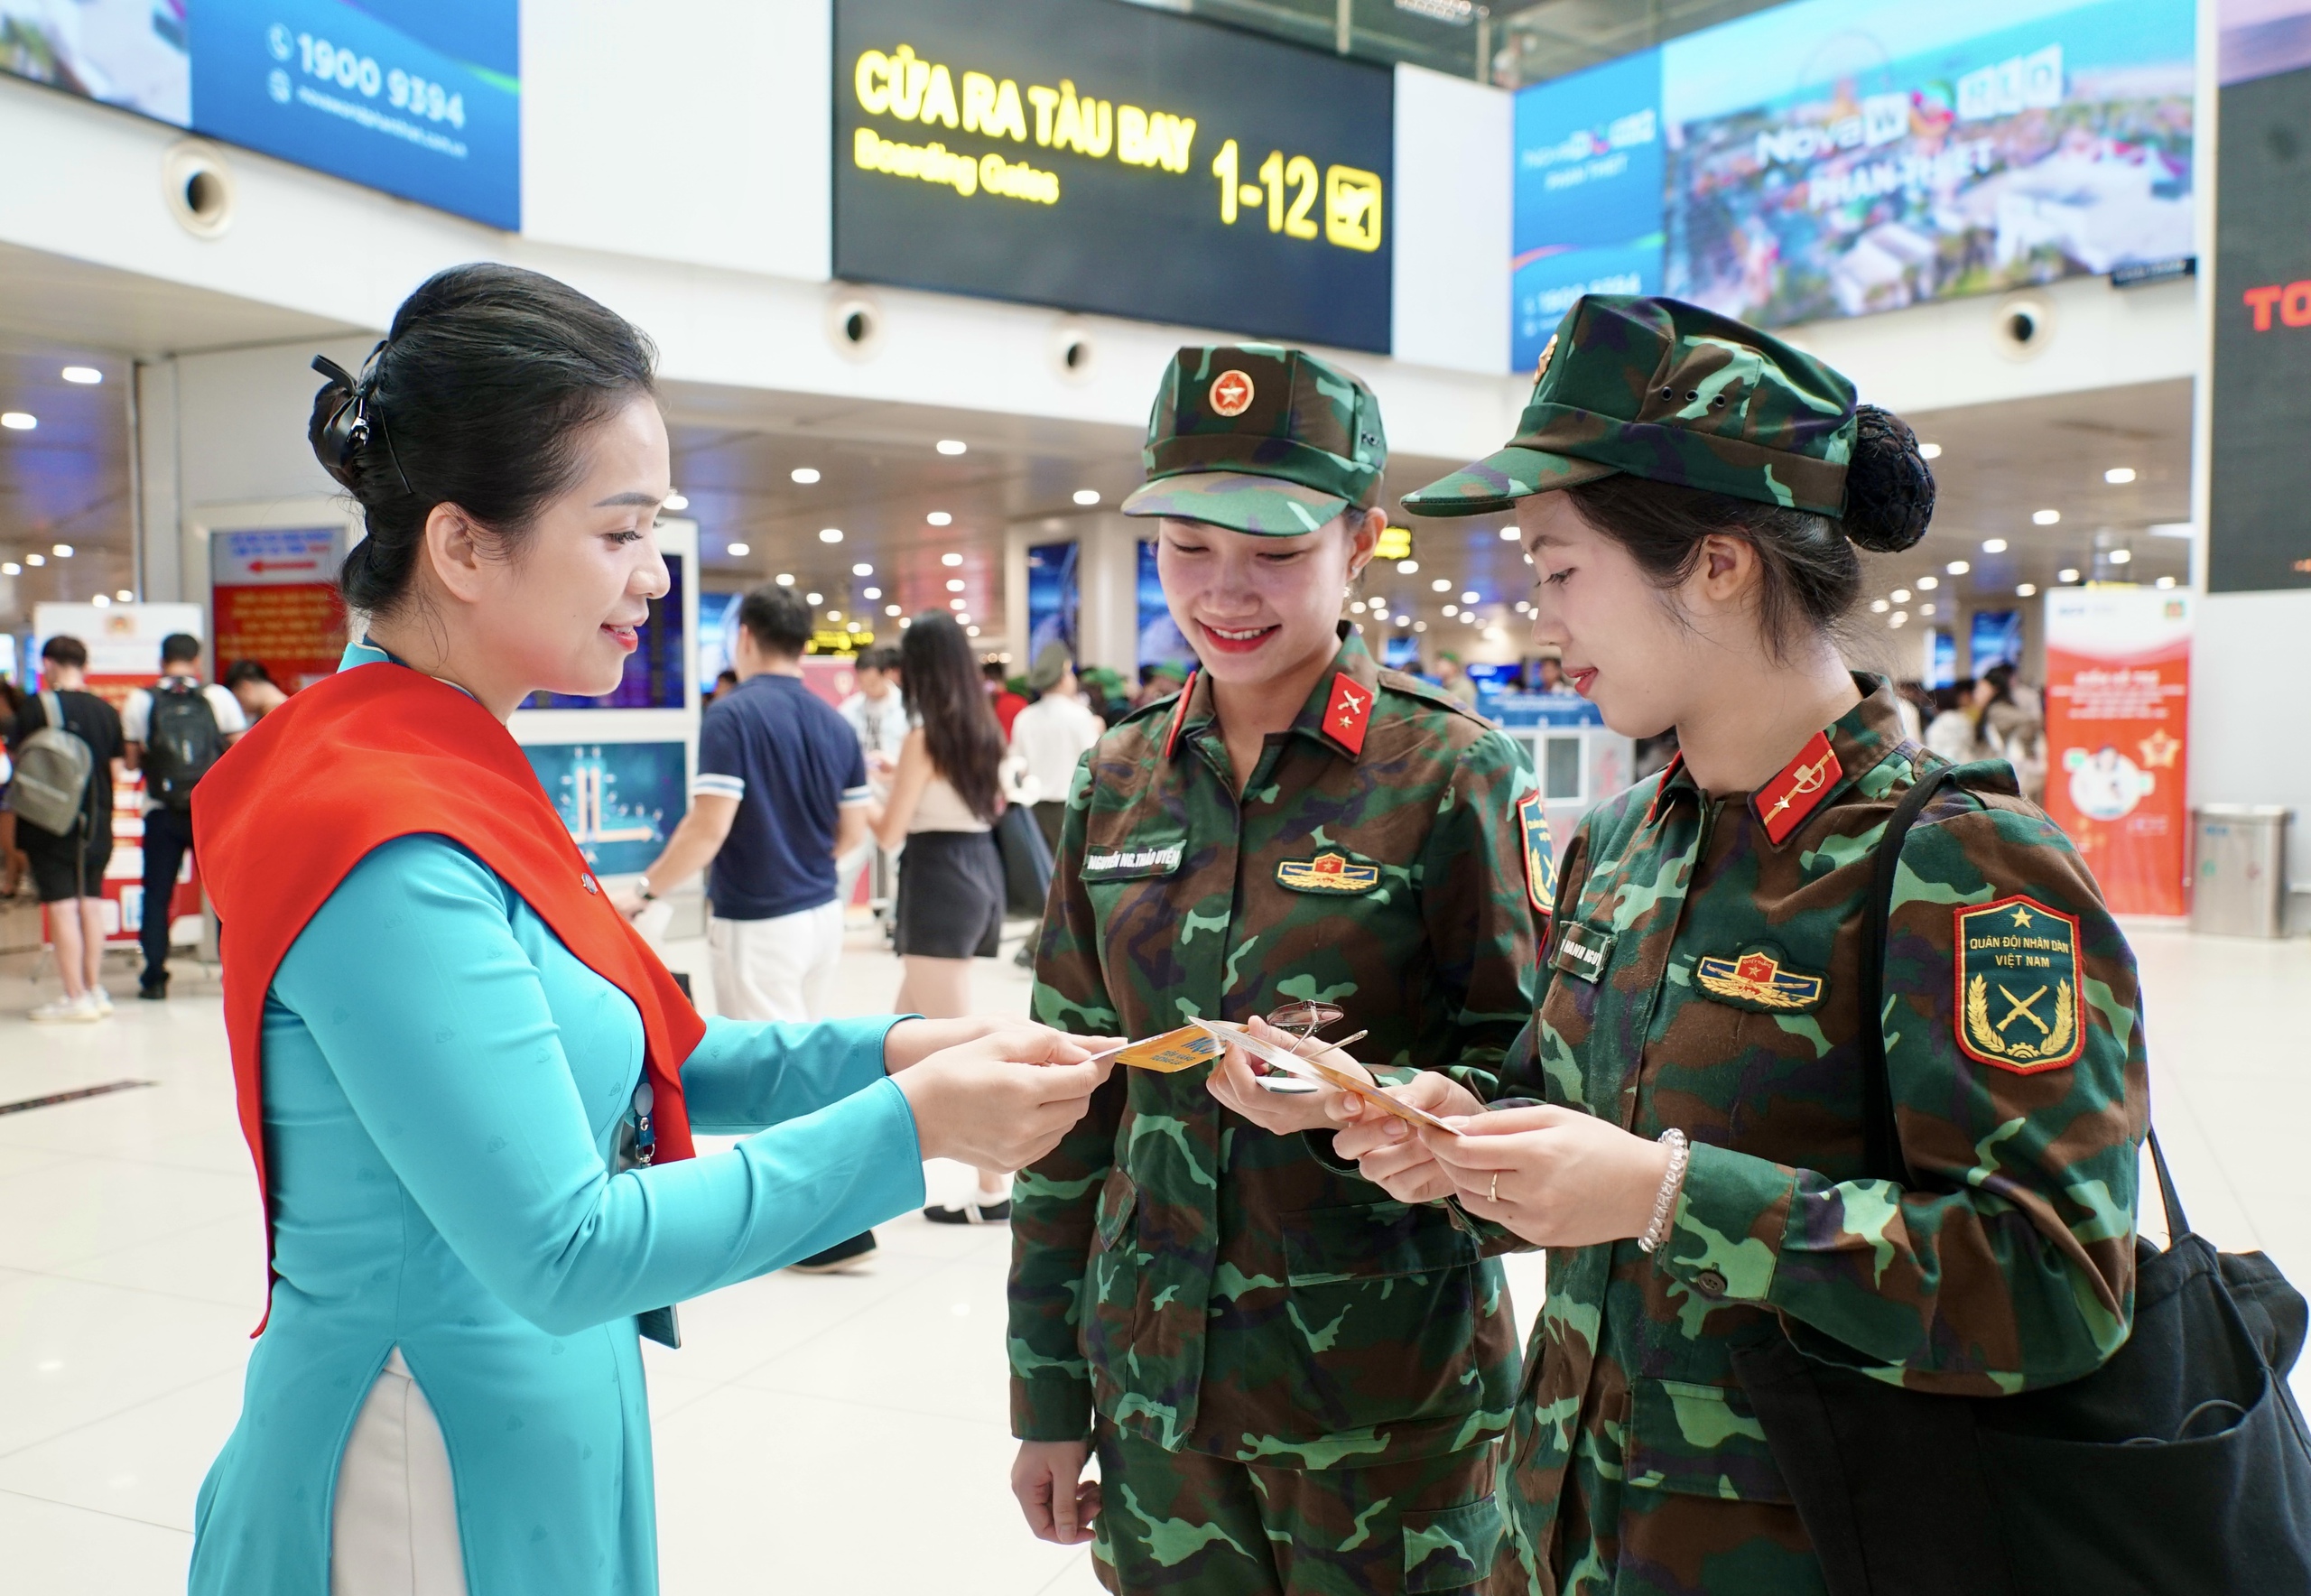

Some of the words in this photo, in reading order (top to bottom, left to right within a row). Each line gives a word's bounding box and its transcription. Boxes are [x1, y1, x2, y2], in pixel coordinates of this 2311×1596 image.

[297, 32, 382, 98] 1900
[387, 68, 466, 131] 9394
[854, 43, 960, 129] CỬA
[962, 71, 1027, 142] RA
[1027, 78, 1113, 157] TÀU
[1117, 104, 1197, 173] BAY
[854, 127, 978, 196] Boarding
[979, 153, 1060, 204] Gates
[1212, 138, 1319, 241] 1-12
[1970, 935, 2000, 950] QUÂN
[2002, 934, 2021, 951] ĐỘI
[2023, 937, 2050, 951] NHÂN
[1995, 952, 2022, 968] VIỆT
[2026, 956, 2050, 968] NAM
